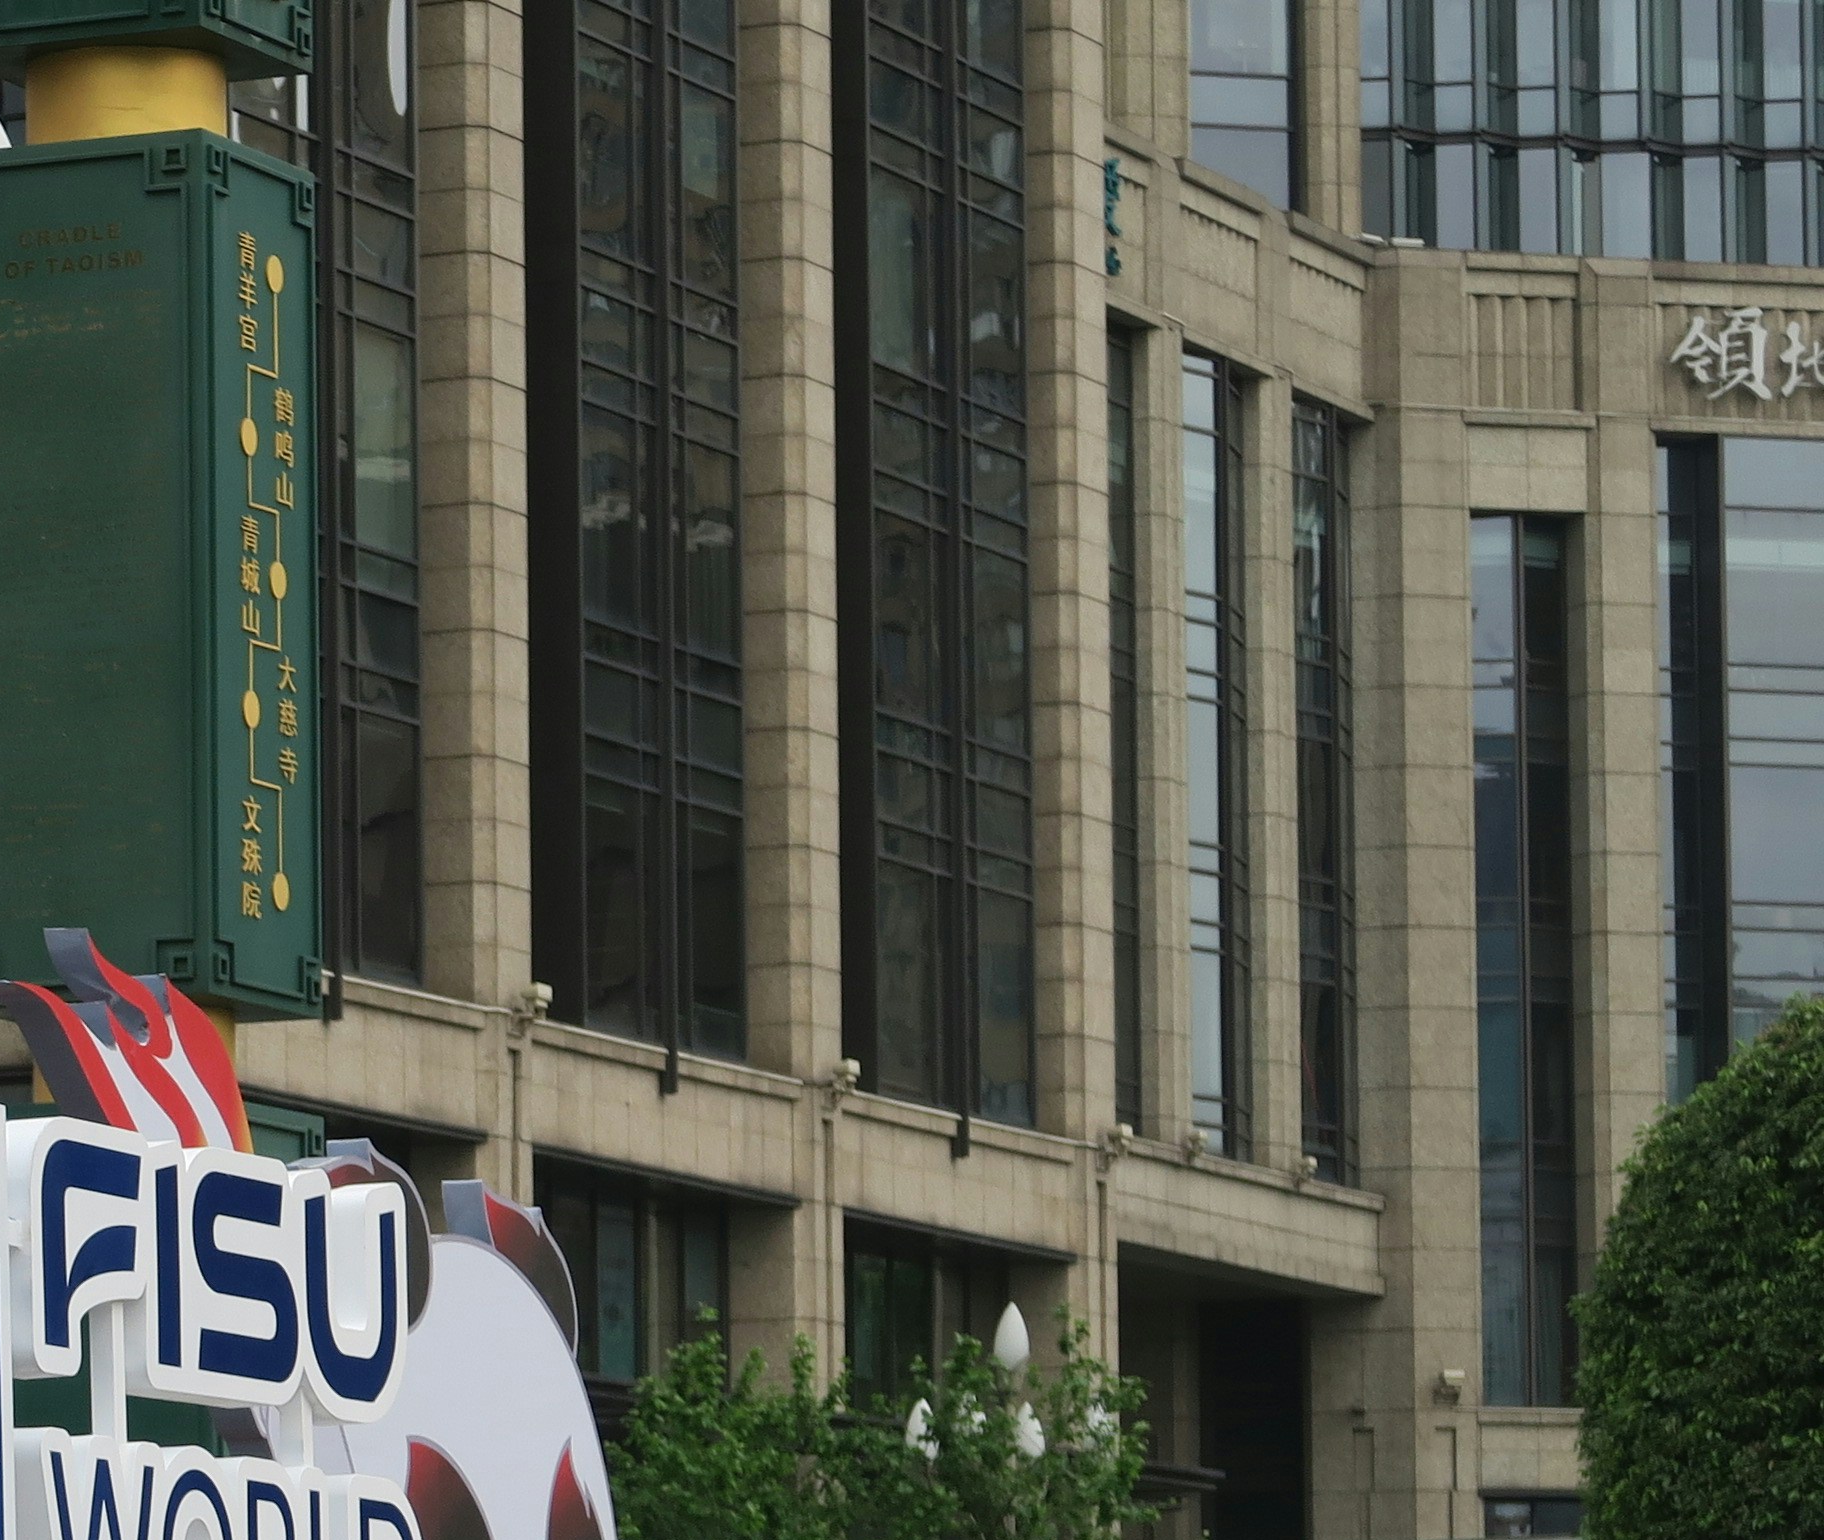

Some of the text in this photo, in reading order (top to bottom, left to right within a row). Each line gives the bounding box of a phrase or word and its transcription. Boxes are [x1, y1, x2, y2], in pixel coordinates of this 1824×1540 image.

[4, 250, 145, 280] OF TAOISM
[19, 223, 121, 249] CRADLE
[238, 231, 259, 353] 青羊宫
[274, 386, 295, 511] 鹤鸣山
[240, 514, 261, 638] 青城山
[277, 655, 299, 785] 大慈寺
[241, 795, 263, 920] 文殊院
[41, 1138, 396, 1402] FISU
